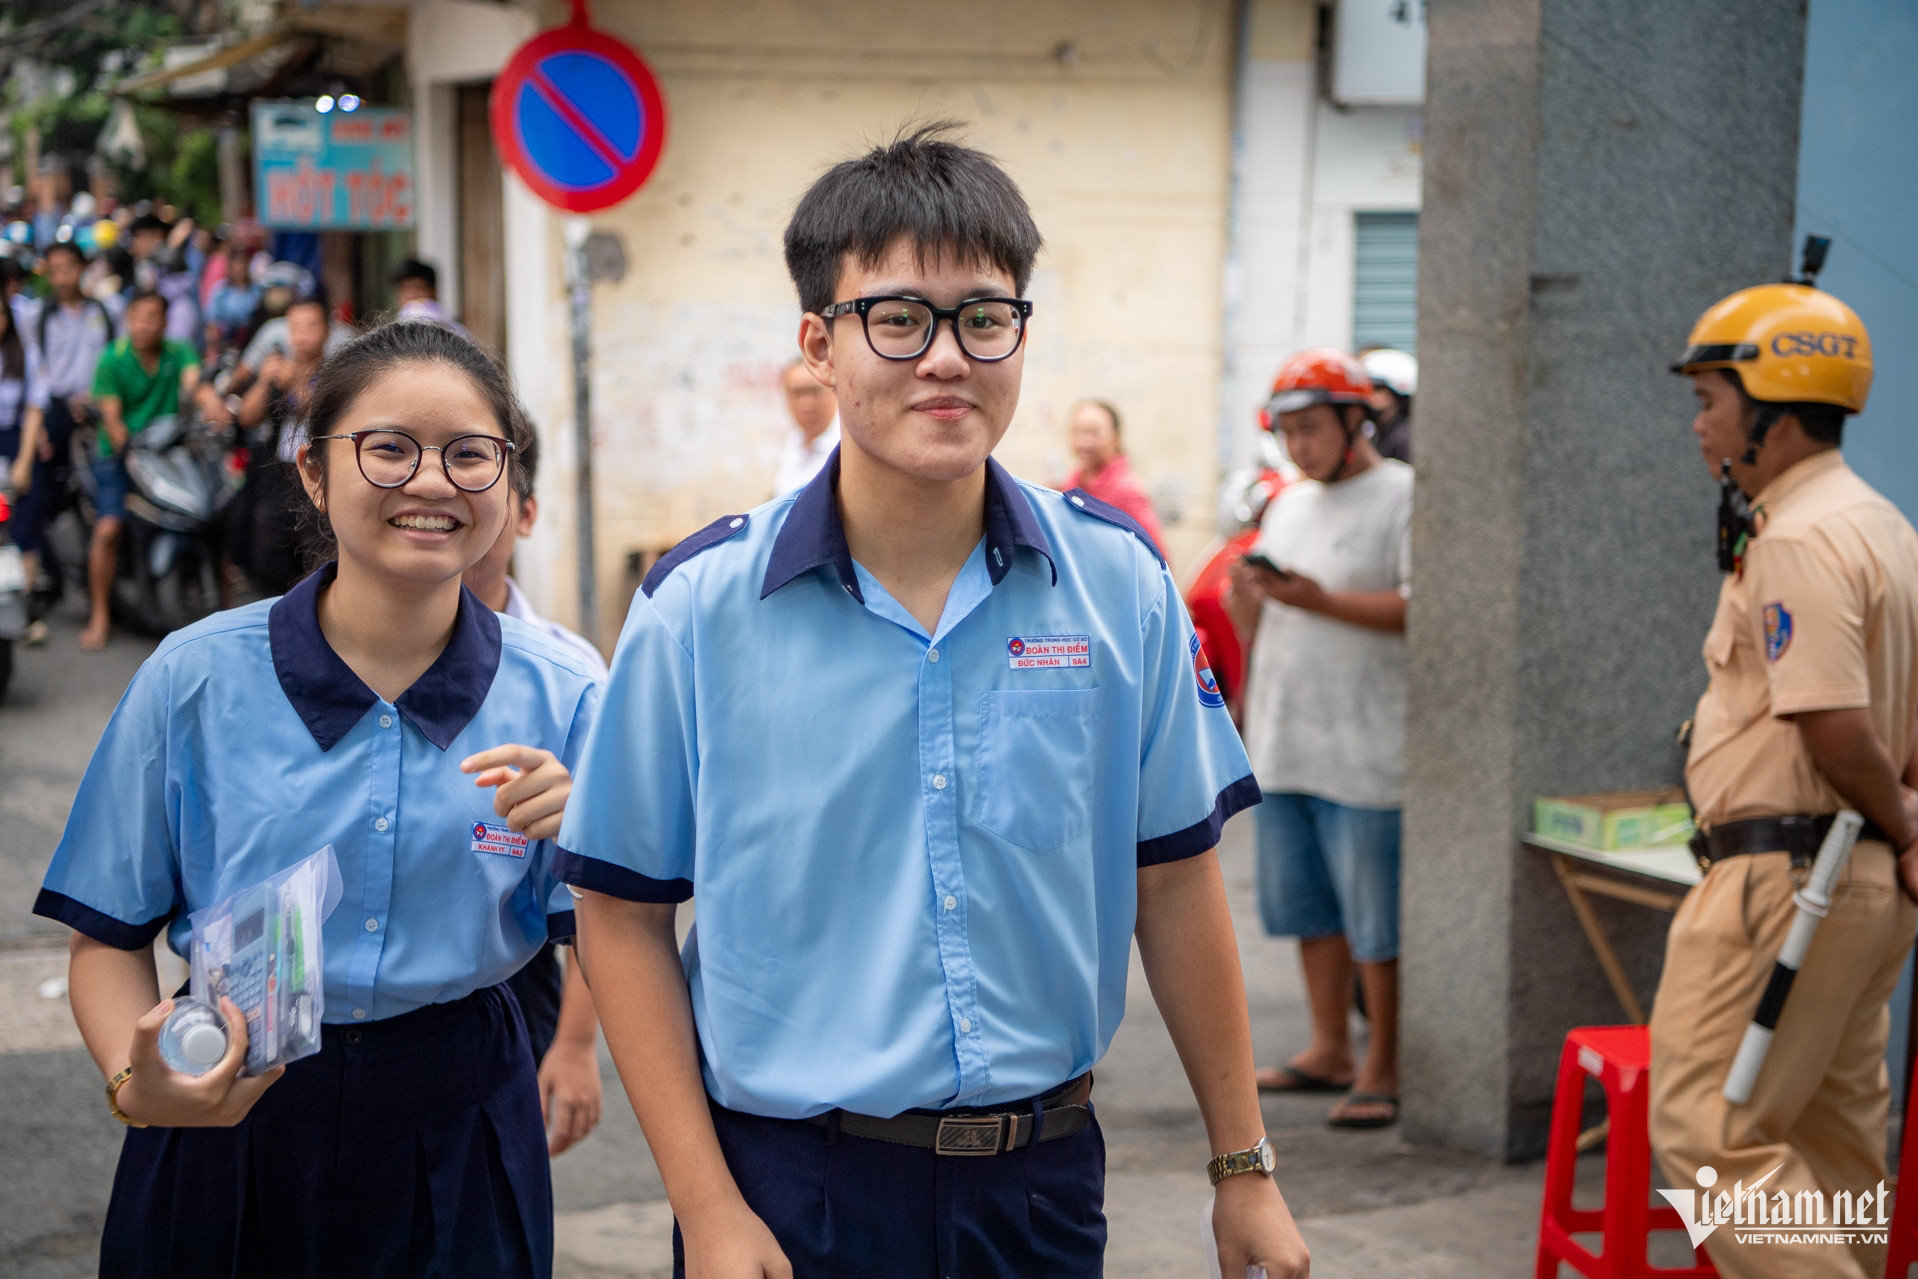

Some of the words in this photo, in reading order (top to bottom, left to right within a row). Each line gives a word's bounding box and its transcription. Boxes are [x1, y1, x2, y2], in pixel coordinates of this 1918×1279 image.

[1771, 329, 1857, 360] CSGT
[1026, 645, 1049, 655] ĐOÀN
[1052, 646, 1065, 655] THỊ
[1067, 642, 1088, 653] ĐIỂM
[1018, 658, 1035, 667] ĐỨC
[1037, 657, 1060, 666] NHÂN
[486, 833, 501, 842] ĐOÀN
[511, 834, 527, 846] ĐIỂM
